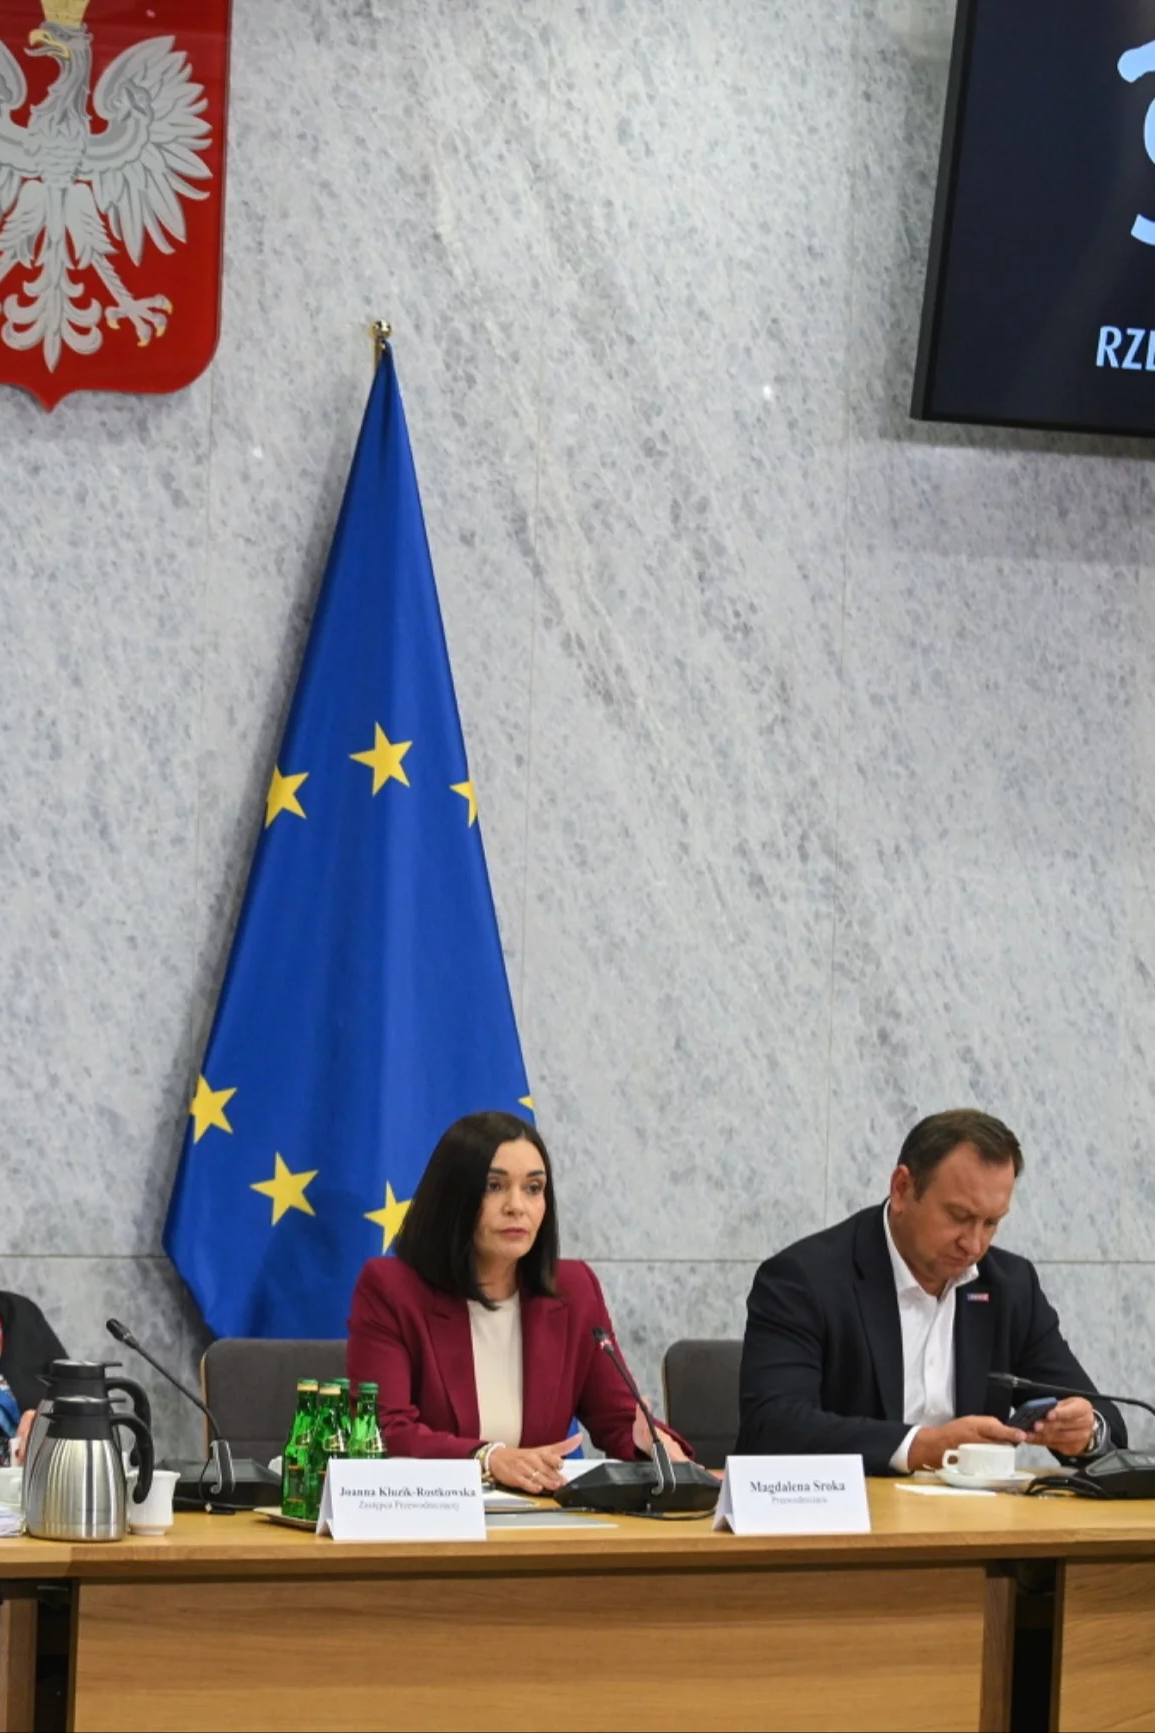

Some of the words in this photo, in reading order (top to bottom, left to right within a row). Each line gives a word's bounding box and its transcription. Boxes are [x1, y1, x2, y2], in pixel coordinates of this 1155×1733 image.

[339, 1486, 376, 1497] Joanna
[379, 1486, 476, 1497] Kluzik-Rostkowska
[750, 1481, 811, 1494] Magdalena
[812, 1480, 846, 1492] Sroka
